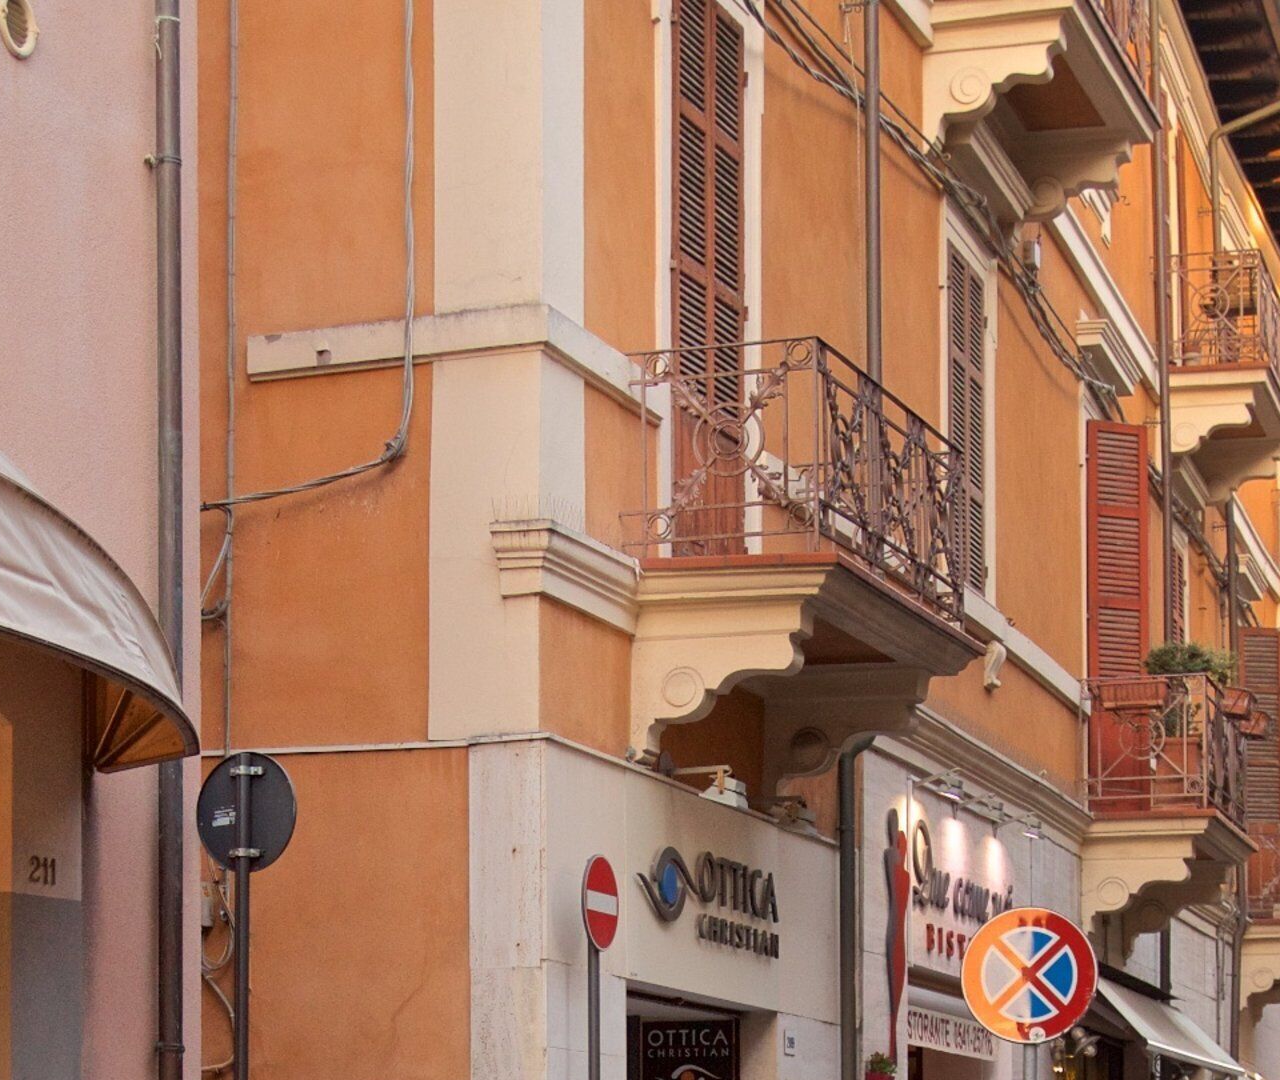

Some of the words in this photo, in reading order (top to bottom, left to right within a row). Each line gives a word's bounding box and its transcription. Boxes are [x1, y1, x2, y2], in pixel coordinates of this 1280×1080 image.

[28, 855, 57, 886] 211
[694, 850, 780, 924] OTTICA
[695, 913, 780, 960] CHRISTIAN
[925, 923, 973, 962] BIST
[647, 1028, 729, 1048] OTTICA
[647, 1047, 730, 1059] CHRISTIAN
